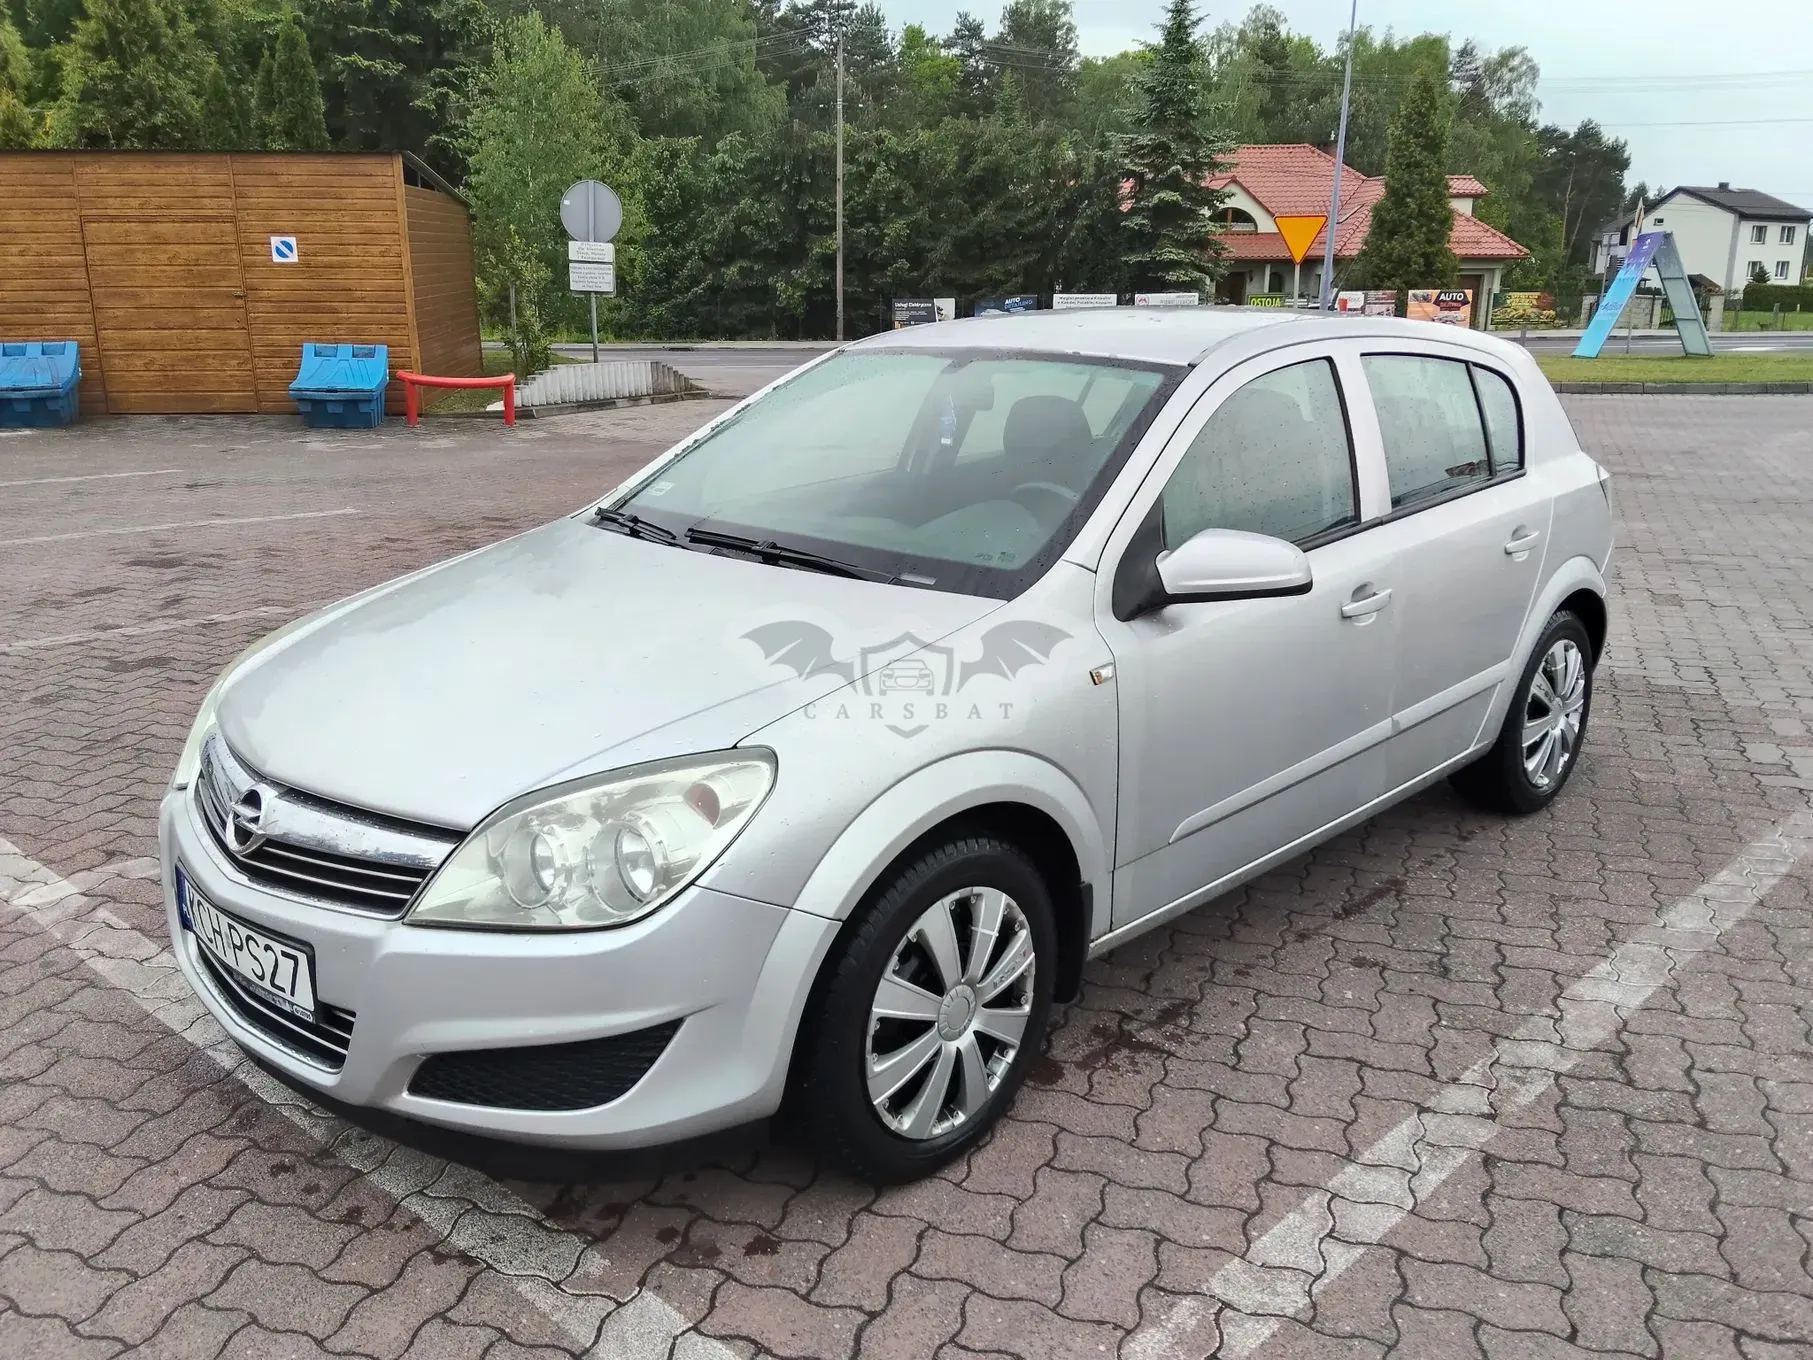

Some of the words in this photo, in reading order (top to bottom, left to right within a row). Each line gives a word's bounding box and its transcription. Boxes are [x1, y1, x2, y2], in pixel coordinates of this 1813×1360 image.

[1439, 292, 1464, 301] AUTO
[1250, 297, 1281, 307] OSTOJA
[227, 921, 299, 997] PS27
